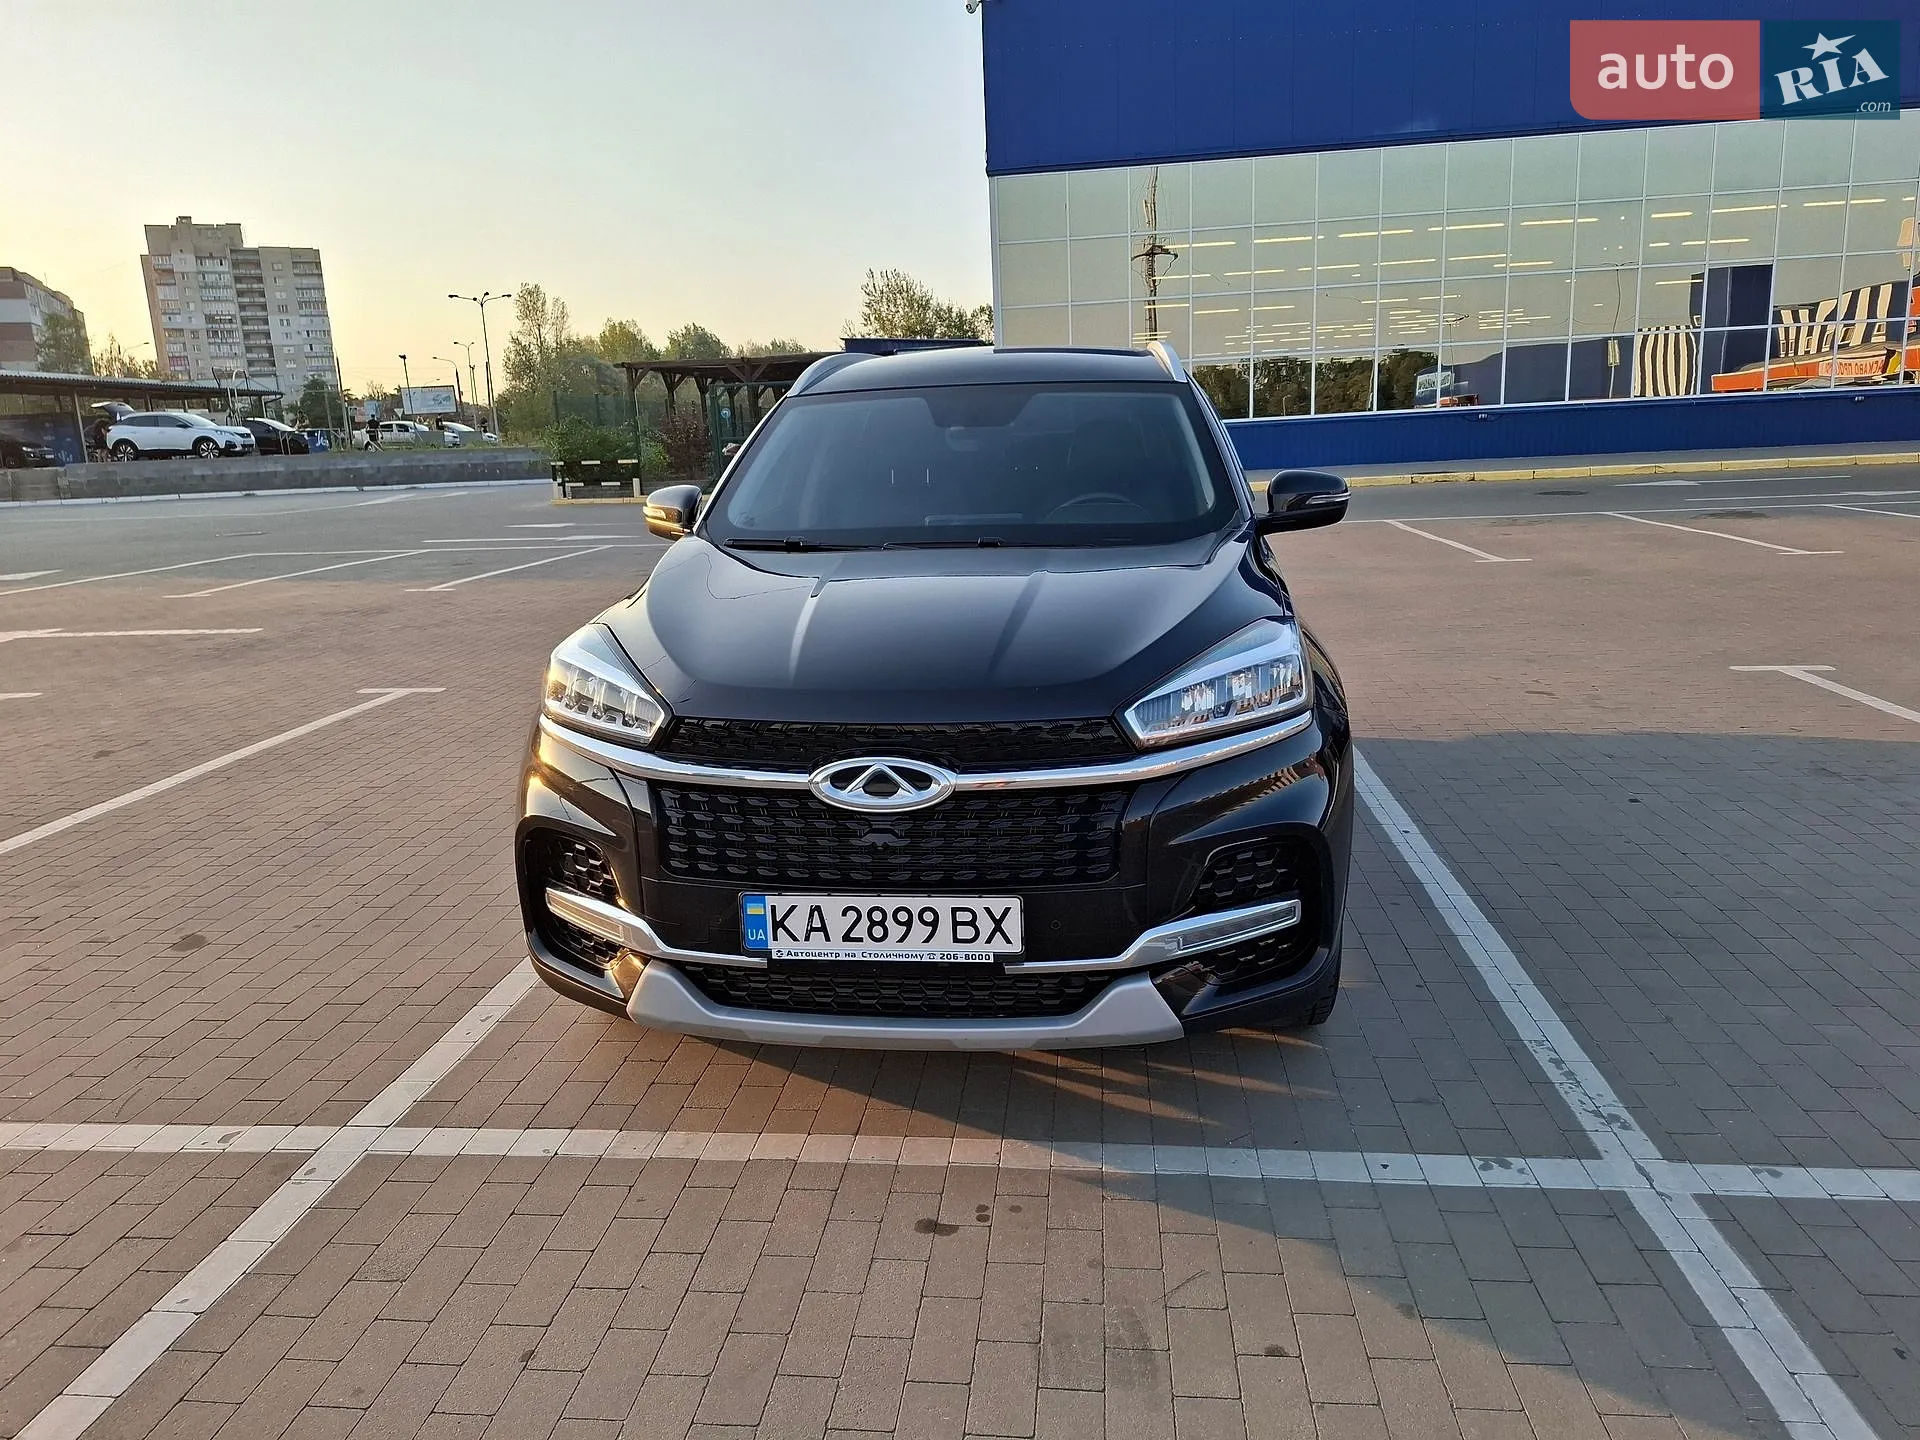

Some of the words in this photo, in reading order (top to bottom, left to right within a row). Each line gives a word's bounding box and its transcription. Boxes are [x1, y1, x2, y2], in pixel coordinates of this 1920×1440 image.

[770, 904, 831, 942] KA
[841, 905, 940, 944] 2899
[950, 906, 1013, 945] BX
[748, 929, 766, 941] UA
[786, 950, 840, 959] Автоцентр
[861, 951, 924, 960] Столичному
[939, 953, 991, 961] 206-8000
